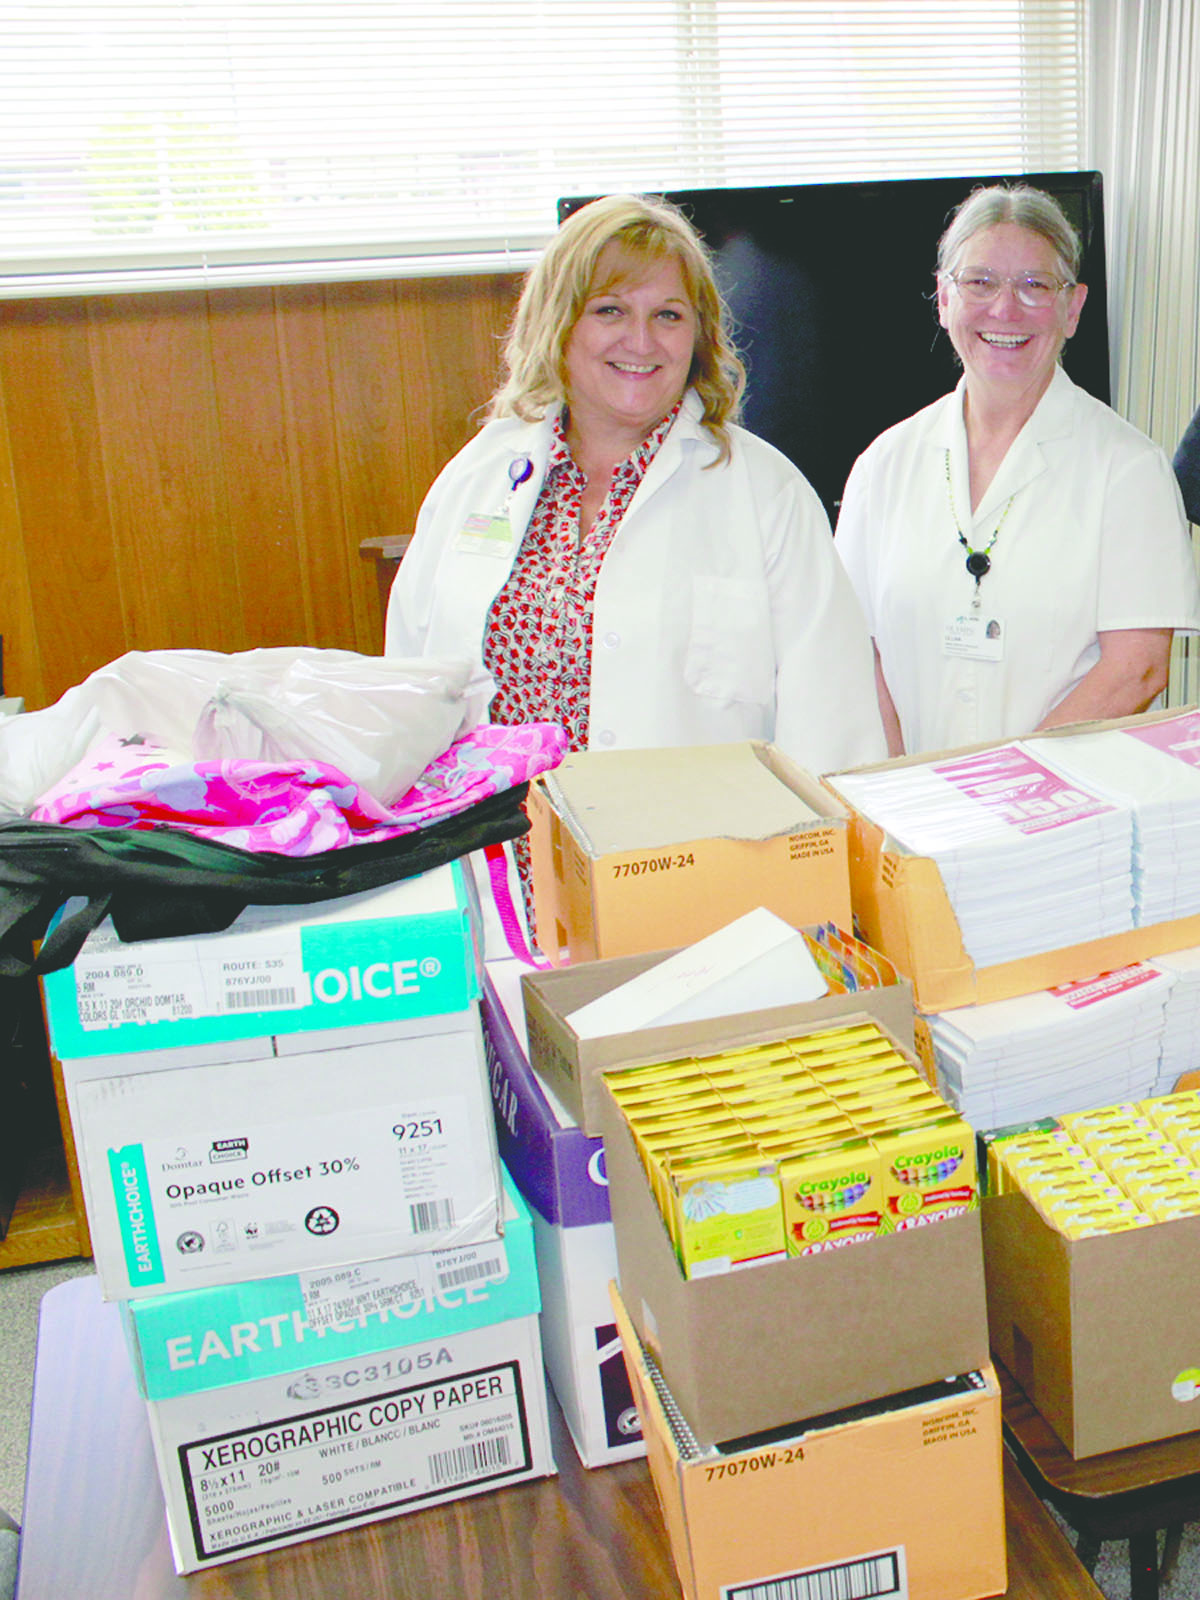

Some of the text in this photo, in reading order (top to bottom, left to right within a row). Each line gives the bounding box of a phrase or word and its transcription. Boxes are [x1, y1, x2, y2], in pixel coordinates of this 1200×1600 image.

[791, 850, 811, 860] MADE
[820, 847, 834, 856] USA
[613, 853, 696, 879] 77070W-24
[85, 970, 110, 980] 2004
[392, 1119, 443, 1141] 9251
[216, 1140, 247, 1151] EARTH
[212, 1150, 243, 1161] CHOICE
[894, 1145, 959, 1170] Crayola
[161, 1159, 203, 1173] Domtar
[166, 1157, 360, 1200] Opaque Offset 30%
[799, 1171, 867, 1196] Crayola
[309, 1277, 333, 1289] 2005
[202, 1376, 503, 1470] XEROGRAPHIC COPY PAPER
[318, 1440, 354, 1459] WHITE
[408, 1418, 441, 1436] BLANC
[923, 1433, 948, 1447] MADE
[258, 1460, 281, 1478] 20#
[705, 1448, 806, 1483] 77070W-24
[321, 1471, 343, 1487] 500
[204, 1500, 235, 1518] 5000
[209, 1512, 293, 1542] XEROGRAPHIC
[308, 1496, 346, 1516] LASER
[348, 1477, 418, 1505] COMPATIBLE
